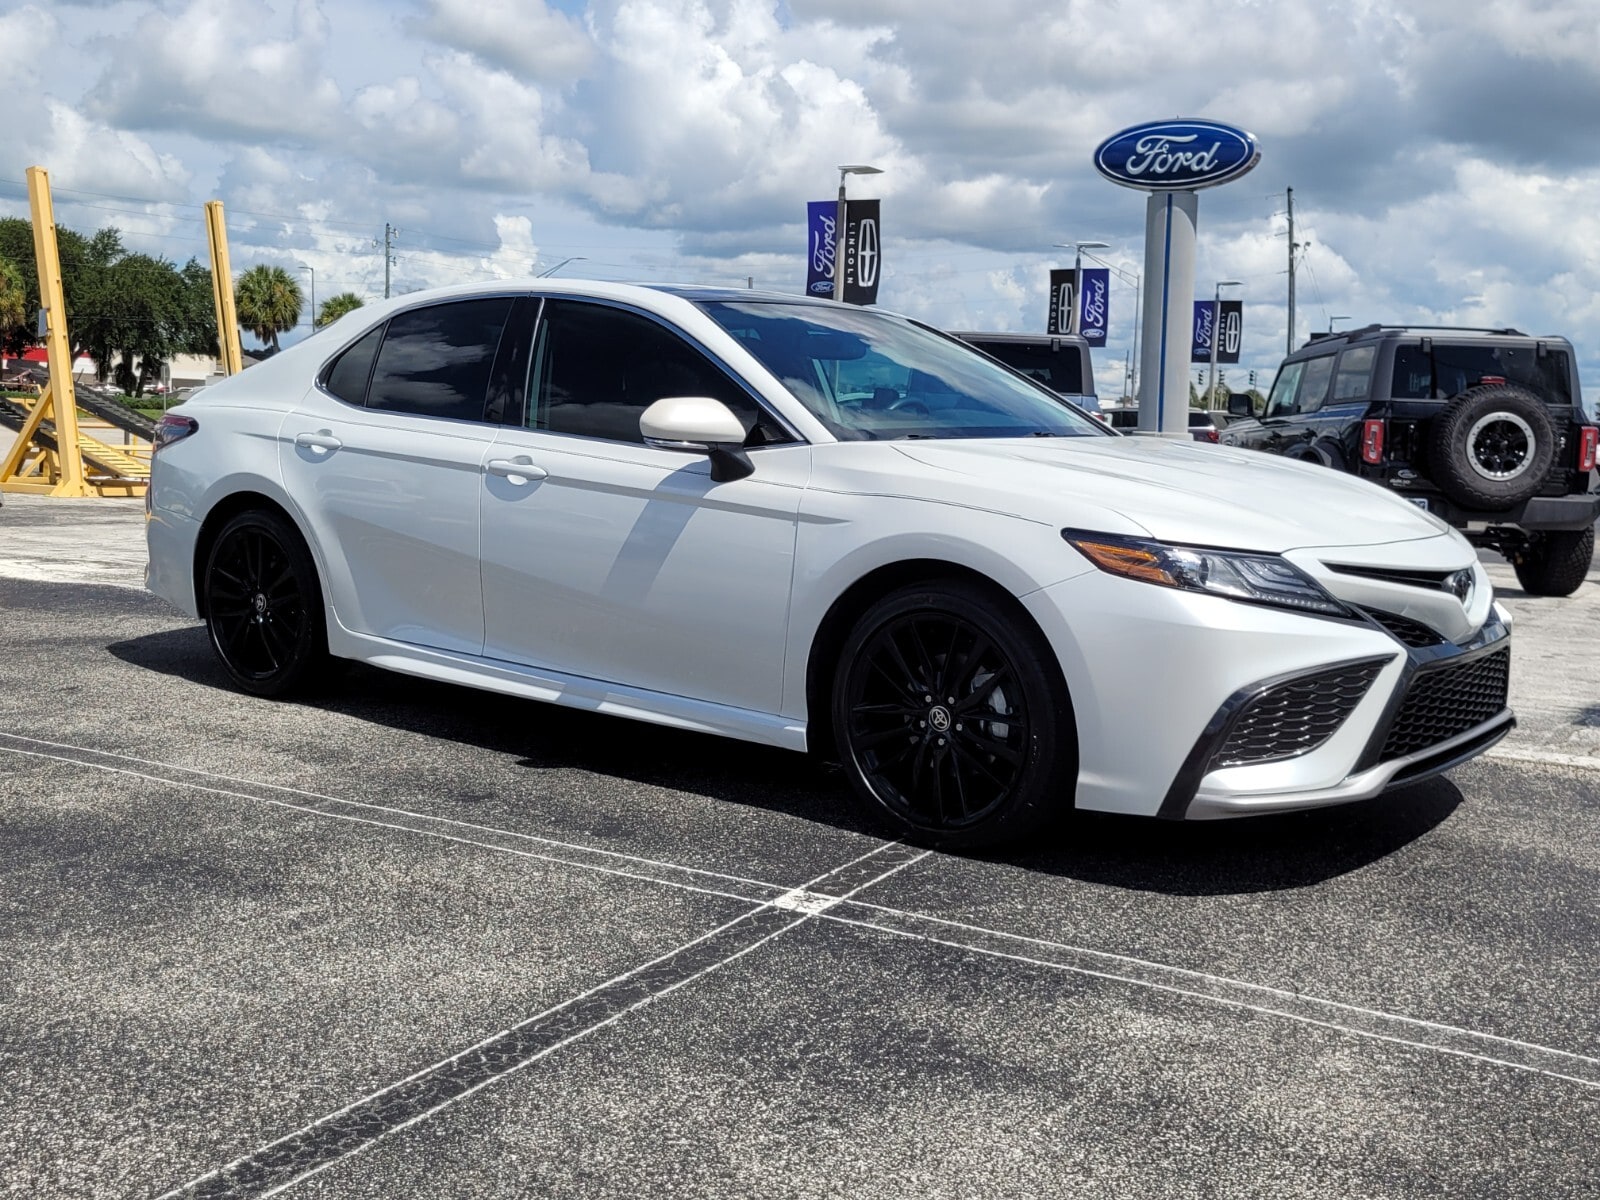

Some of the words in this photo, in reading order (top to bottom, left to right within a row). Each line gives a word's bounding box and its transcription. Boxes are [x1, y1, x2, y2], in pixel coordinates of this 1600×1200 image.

[1126, 134, 1221, 175] Ford
[813, 214, 835, 278] Ford
[847, 222, 856, 284] LINCOLN
[1049, 285, 1057, 331] LINCOLN
[1085, 278, 1105, 327] Ford
[1196, 308, 1213, 347] Ford
